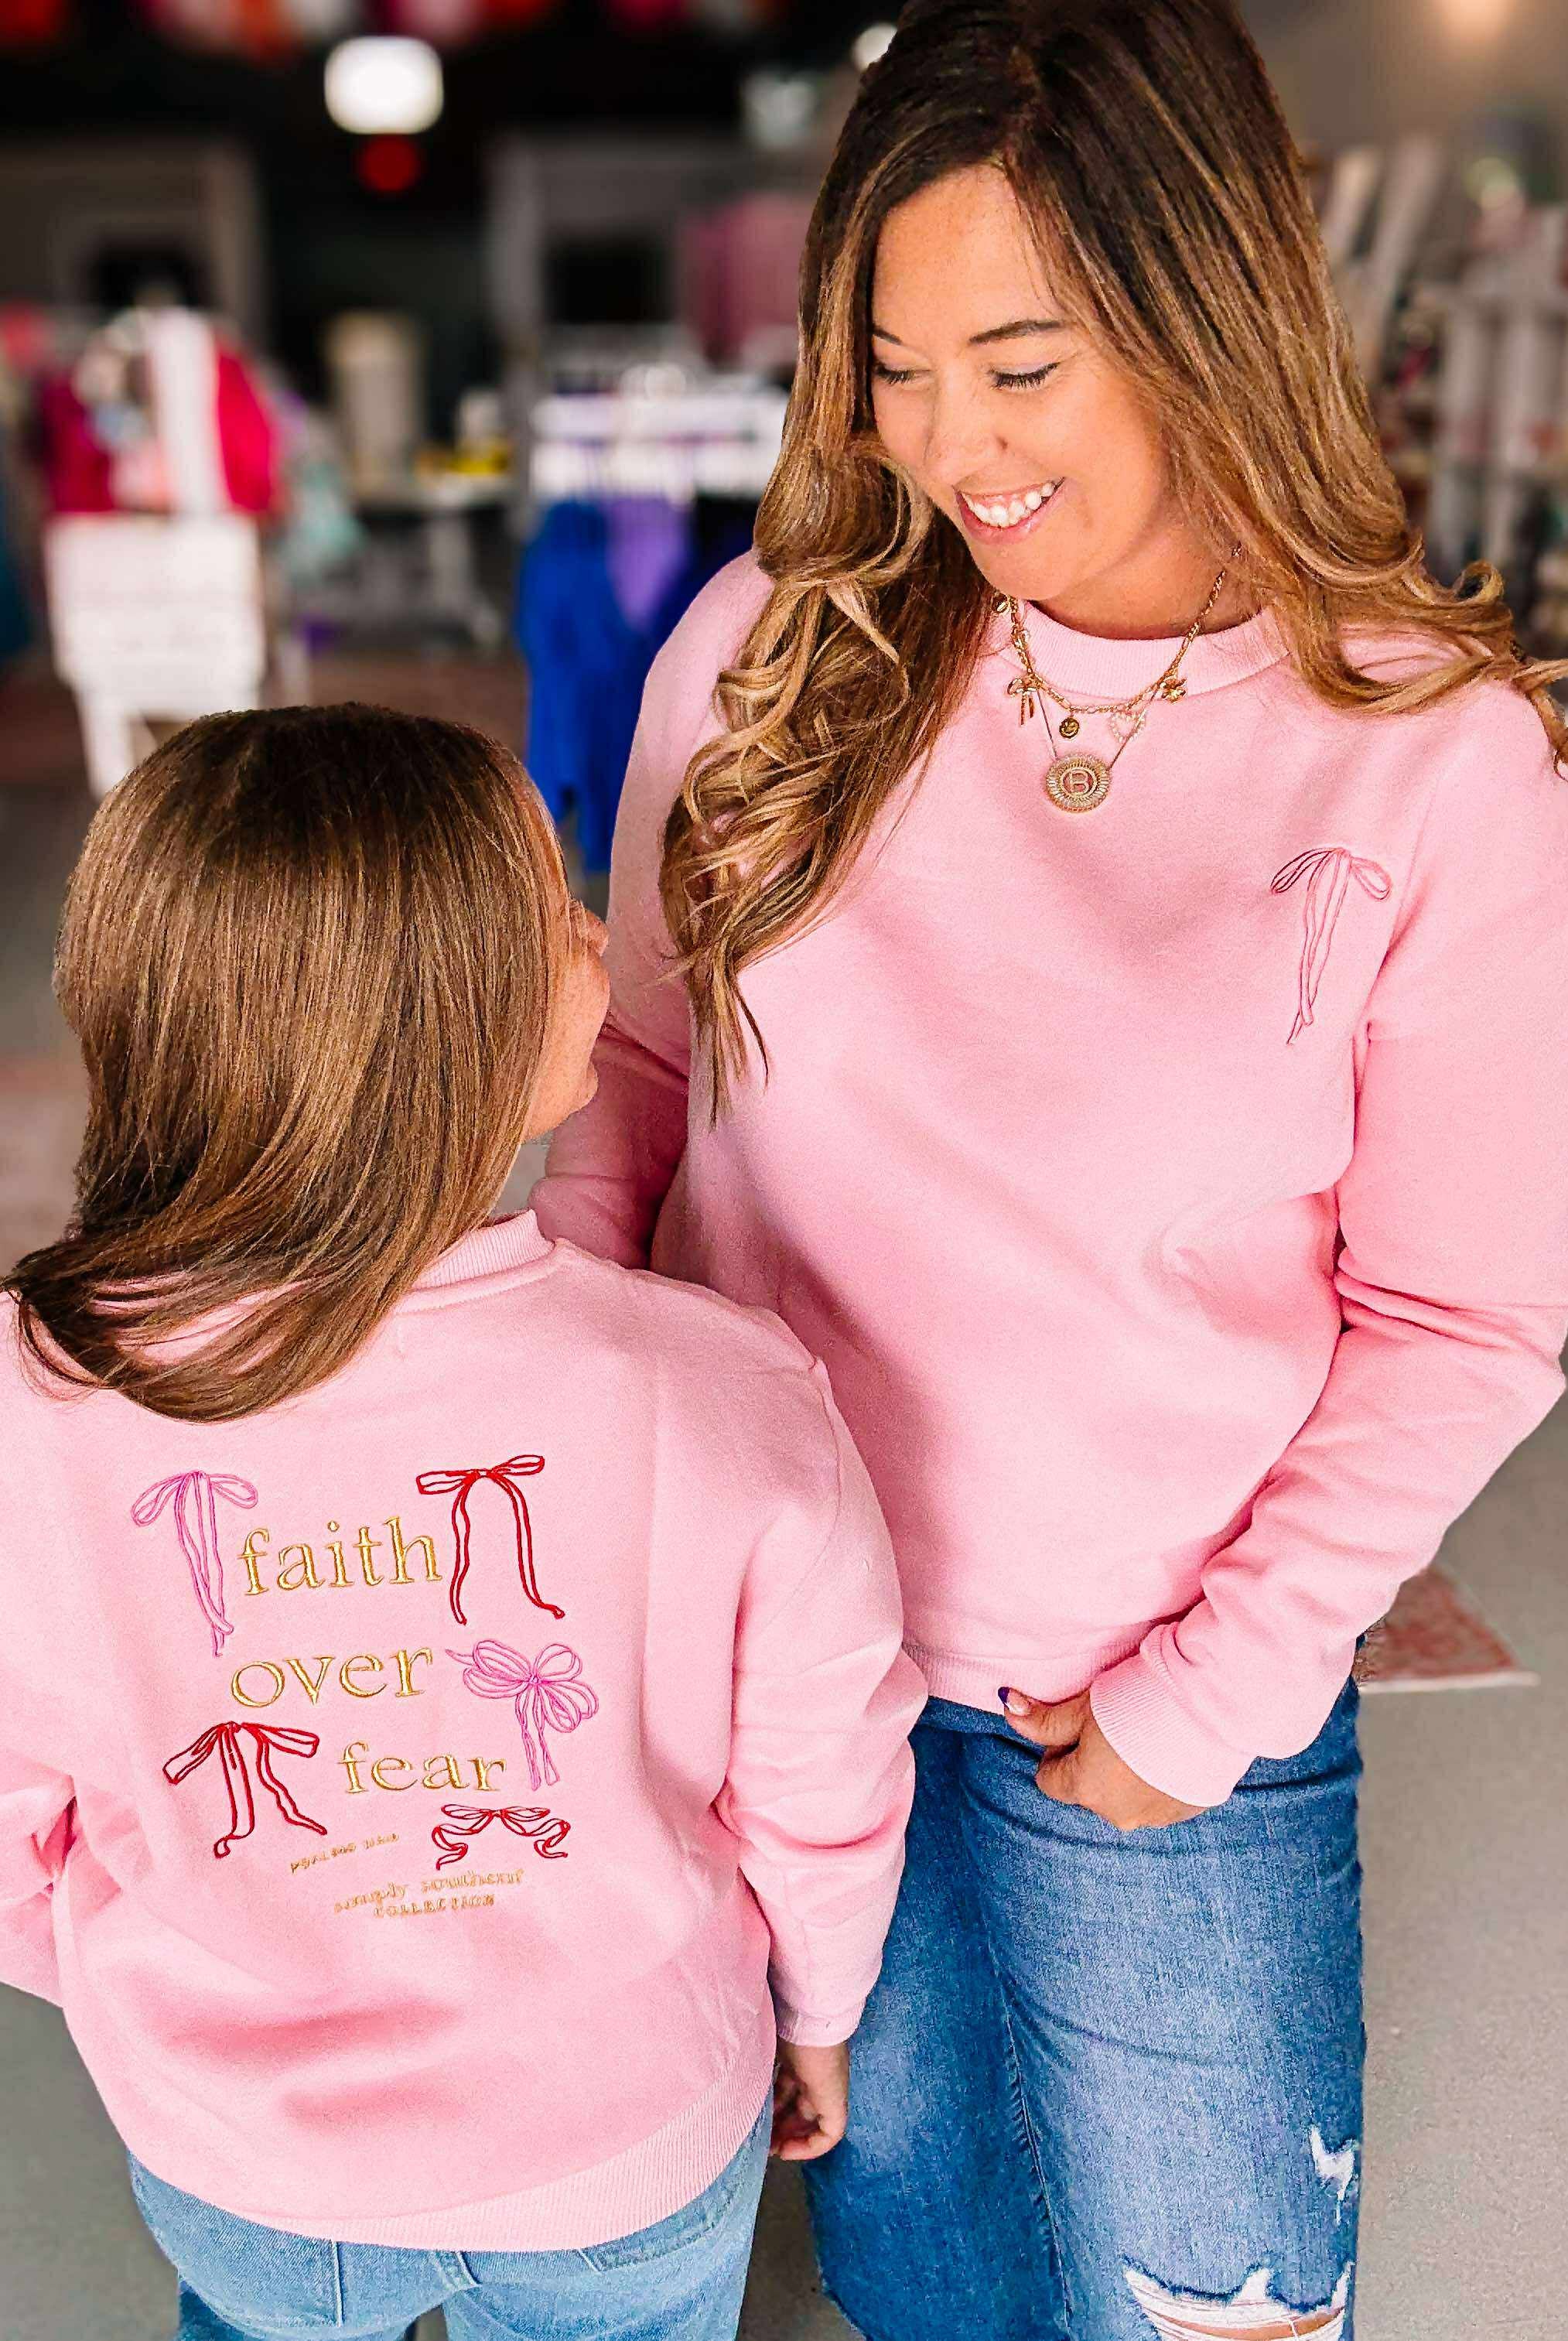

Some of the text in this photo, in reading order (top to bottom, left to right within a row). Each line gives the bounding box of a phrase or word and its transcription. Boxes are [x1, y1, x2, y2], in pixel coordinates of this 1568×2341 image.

[237, 1514, 442, 1597] faith
[231, 1646, 433, 1708] over
[338, 1739, 507, 1795] fear
[373, 1893, 495, 1919] COLLECTION
